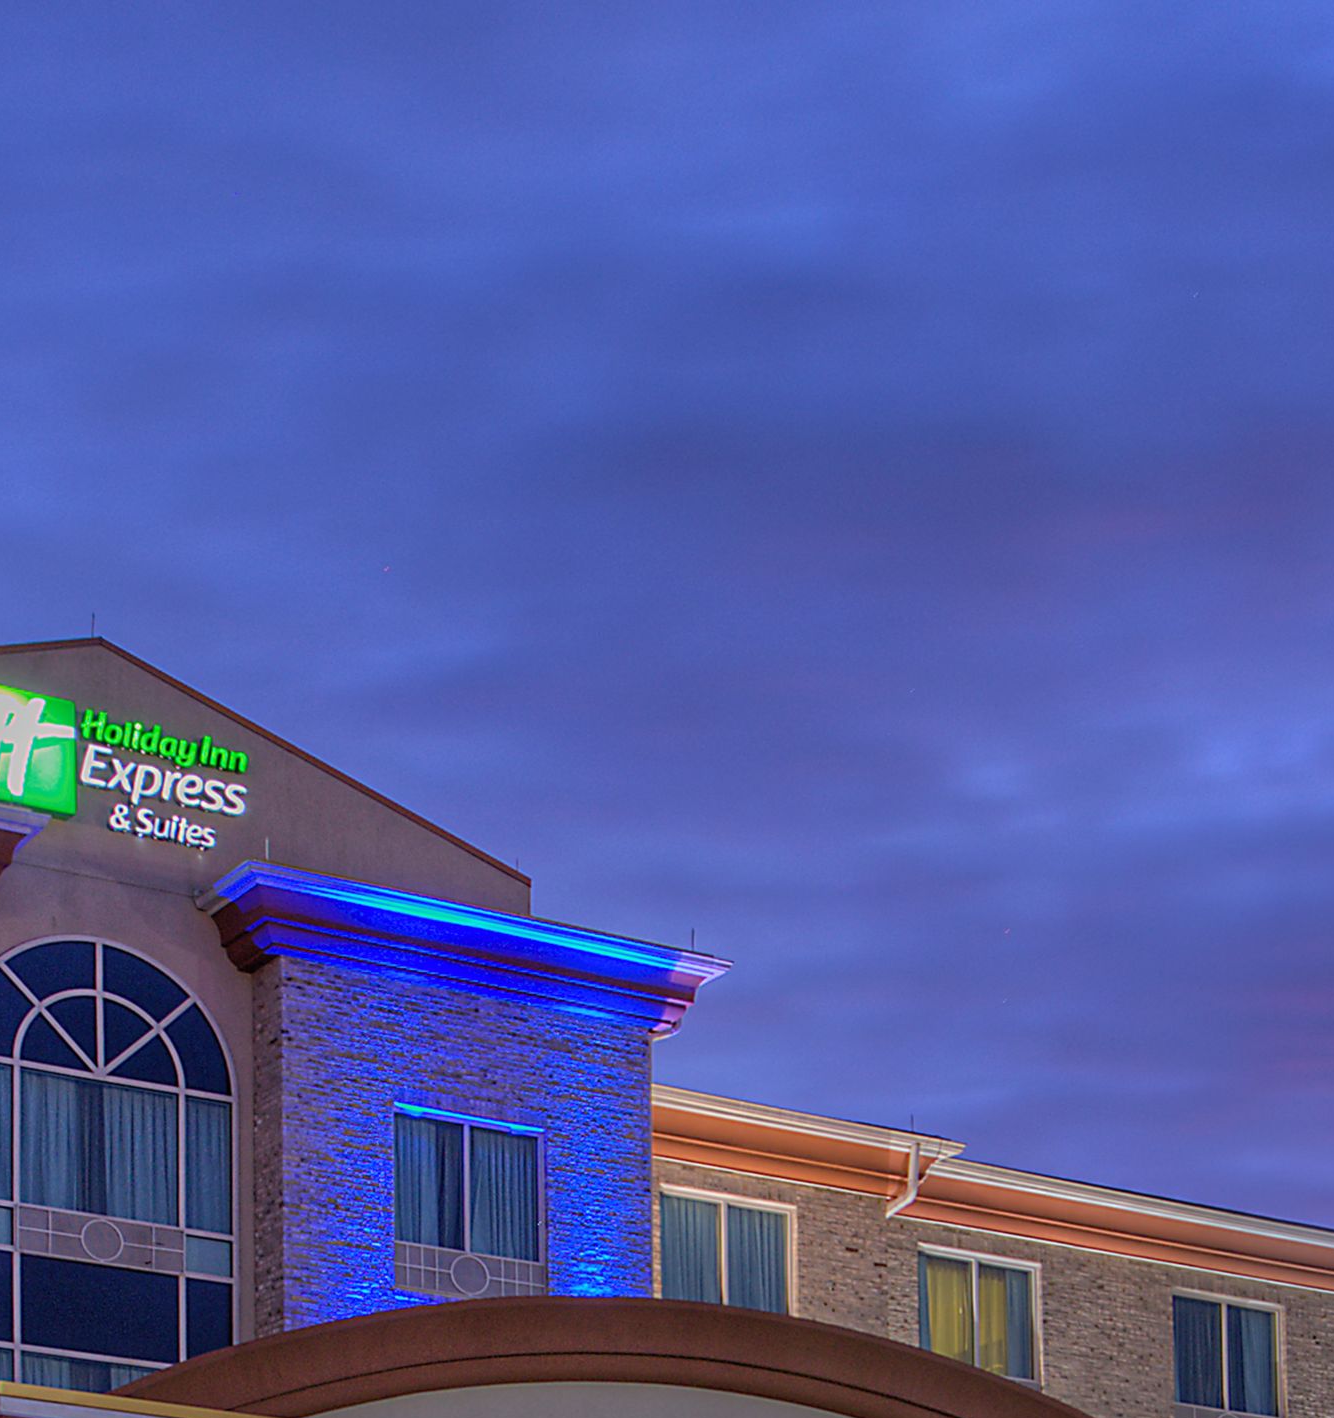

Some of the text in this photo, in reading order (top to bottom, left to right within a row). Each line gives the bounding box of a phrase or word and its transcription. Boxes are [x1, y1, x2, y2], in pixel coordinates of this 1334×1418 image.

[81, 709, 248, 773] Holiday Inn
[80, 744, 247, 816] Express
[109, 804, 216, 849] & Suites
